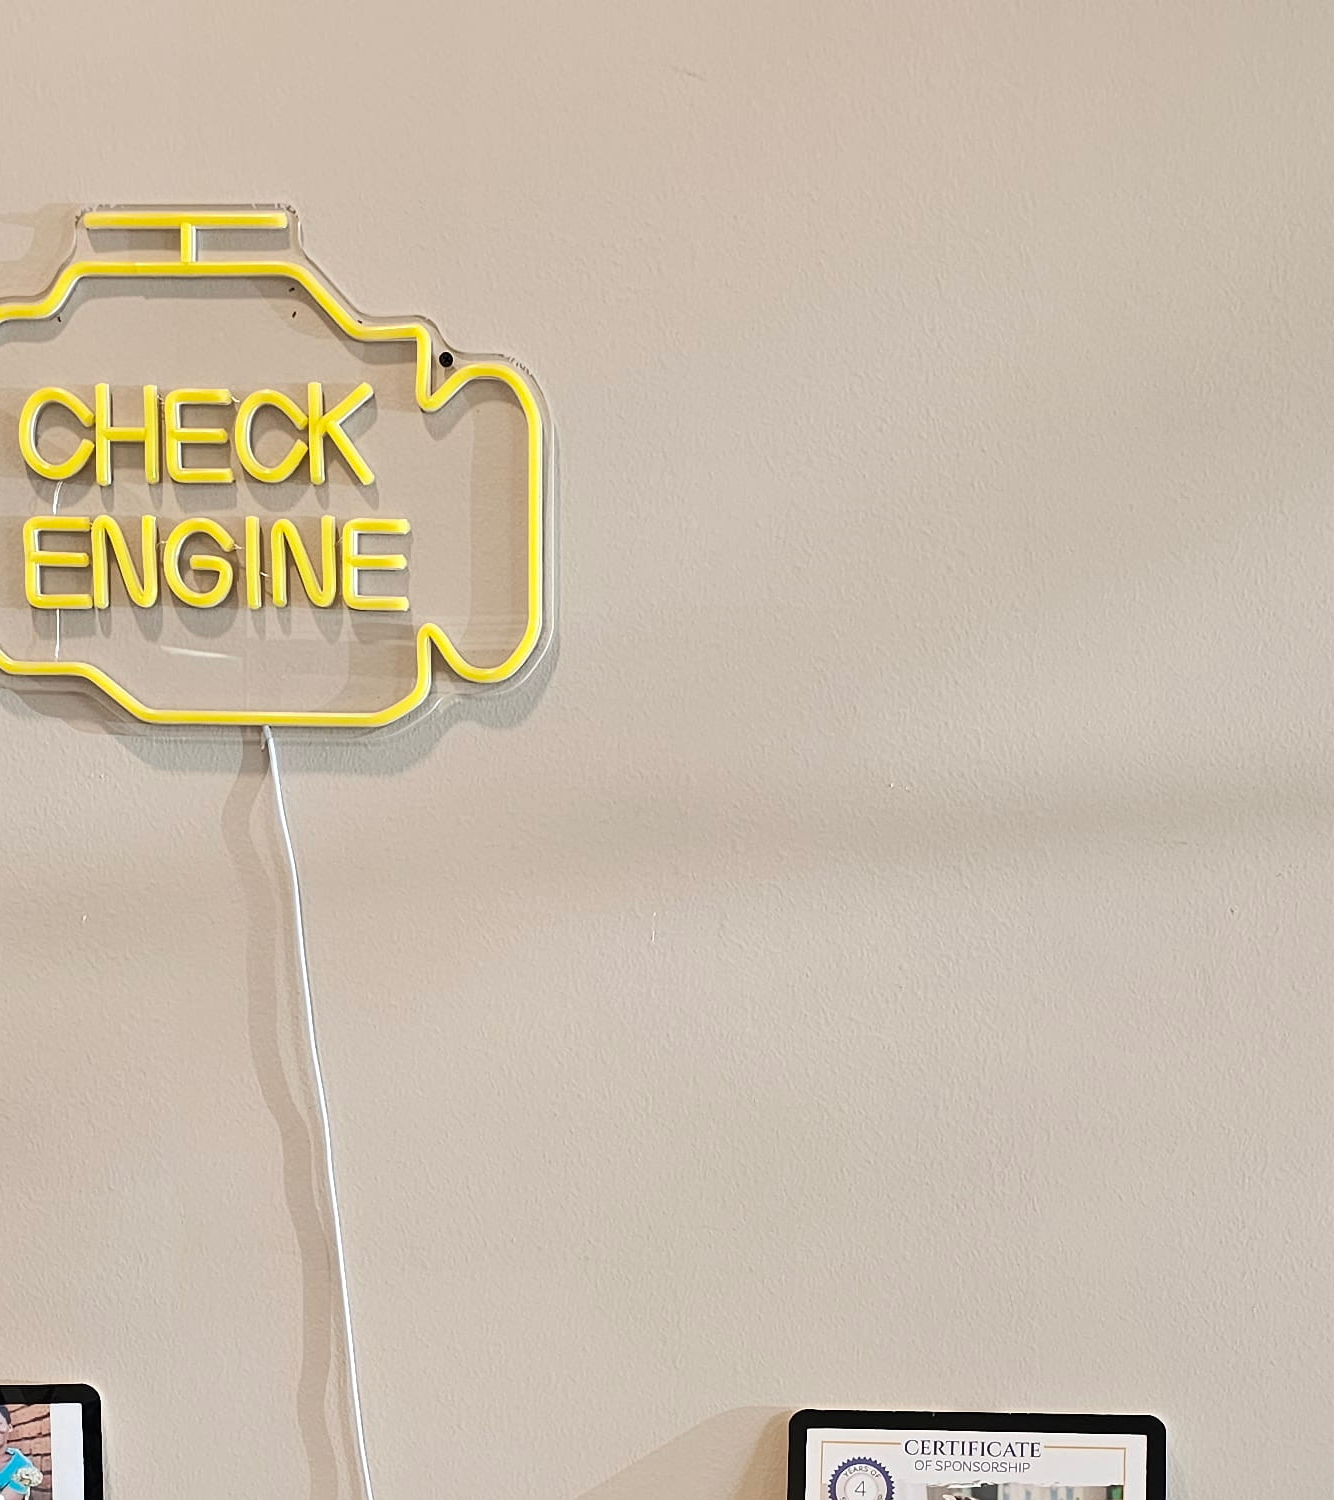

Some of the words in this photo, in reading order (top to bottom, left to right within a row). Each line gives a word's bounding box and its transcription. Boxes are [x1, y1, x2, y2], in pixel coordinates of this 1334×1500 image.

[19, 382, 374, 486] CHECK
[23, 515, 410, 611] ENGINE
[904, 1439, 1042, 1458] CERTIFICATE
[843, 1465, 869, 1478] YEARS
[870, 1469, 882, 1479] OF
[914, 1460, 932, 1471] OF
[935, 1460, 1031, 1473] SPONSORSHIP
[854, 1480, 866, 1497] 4
